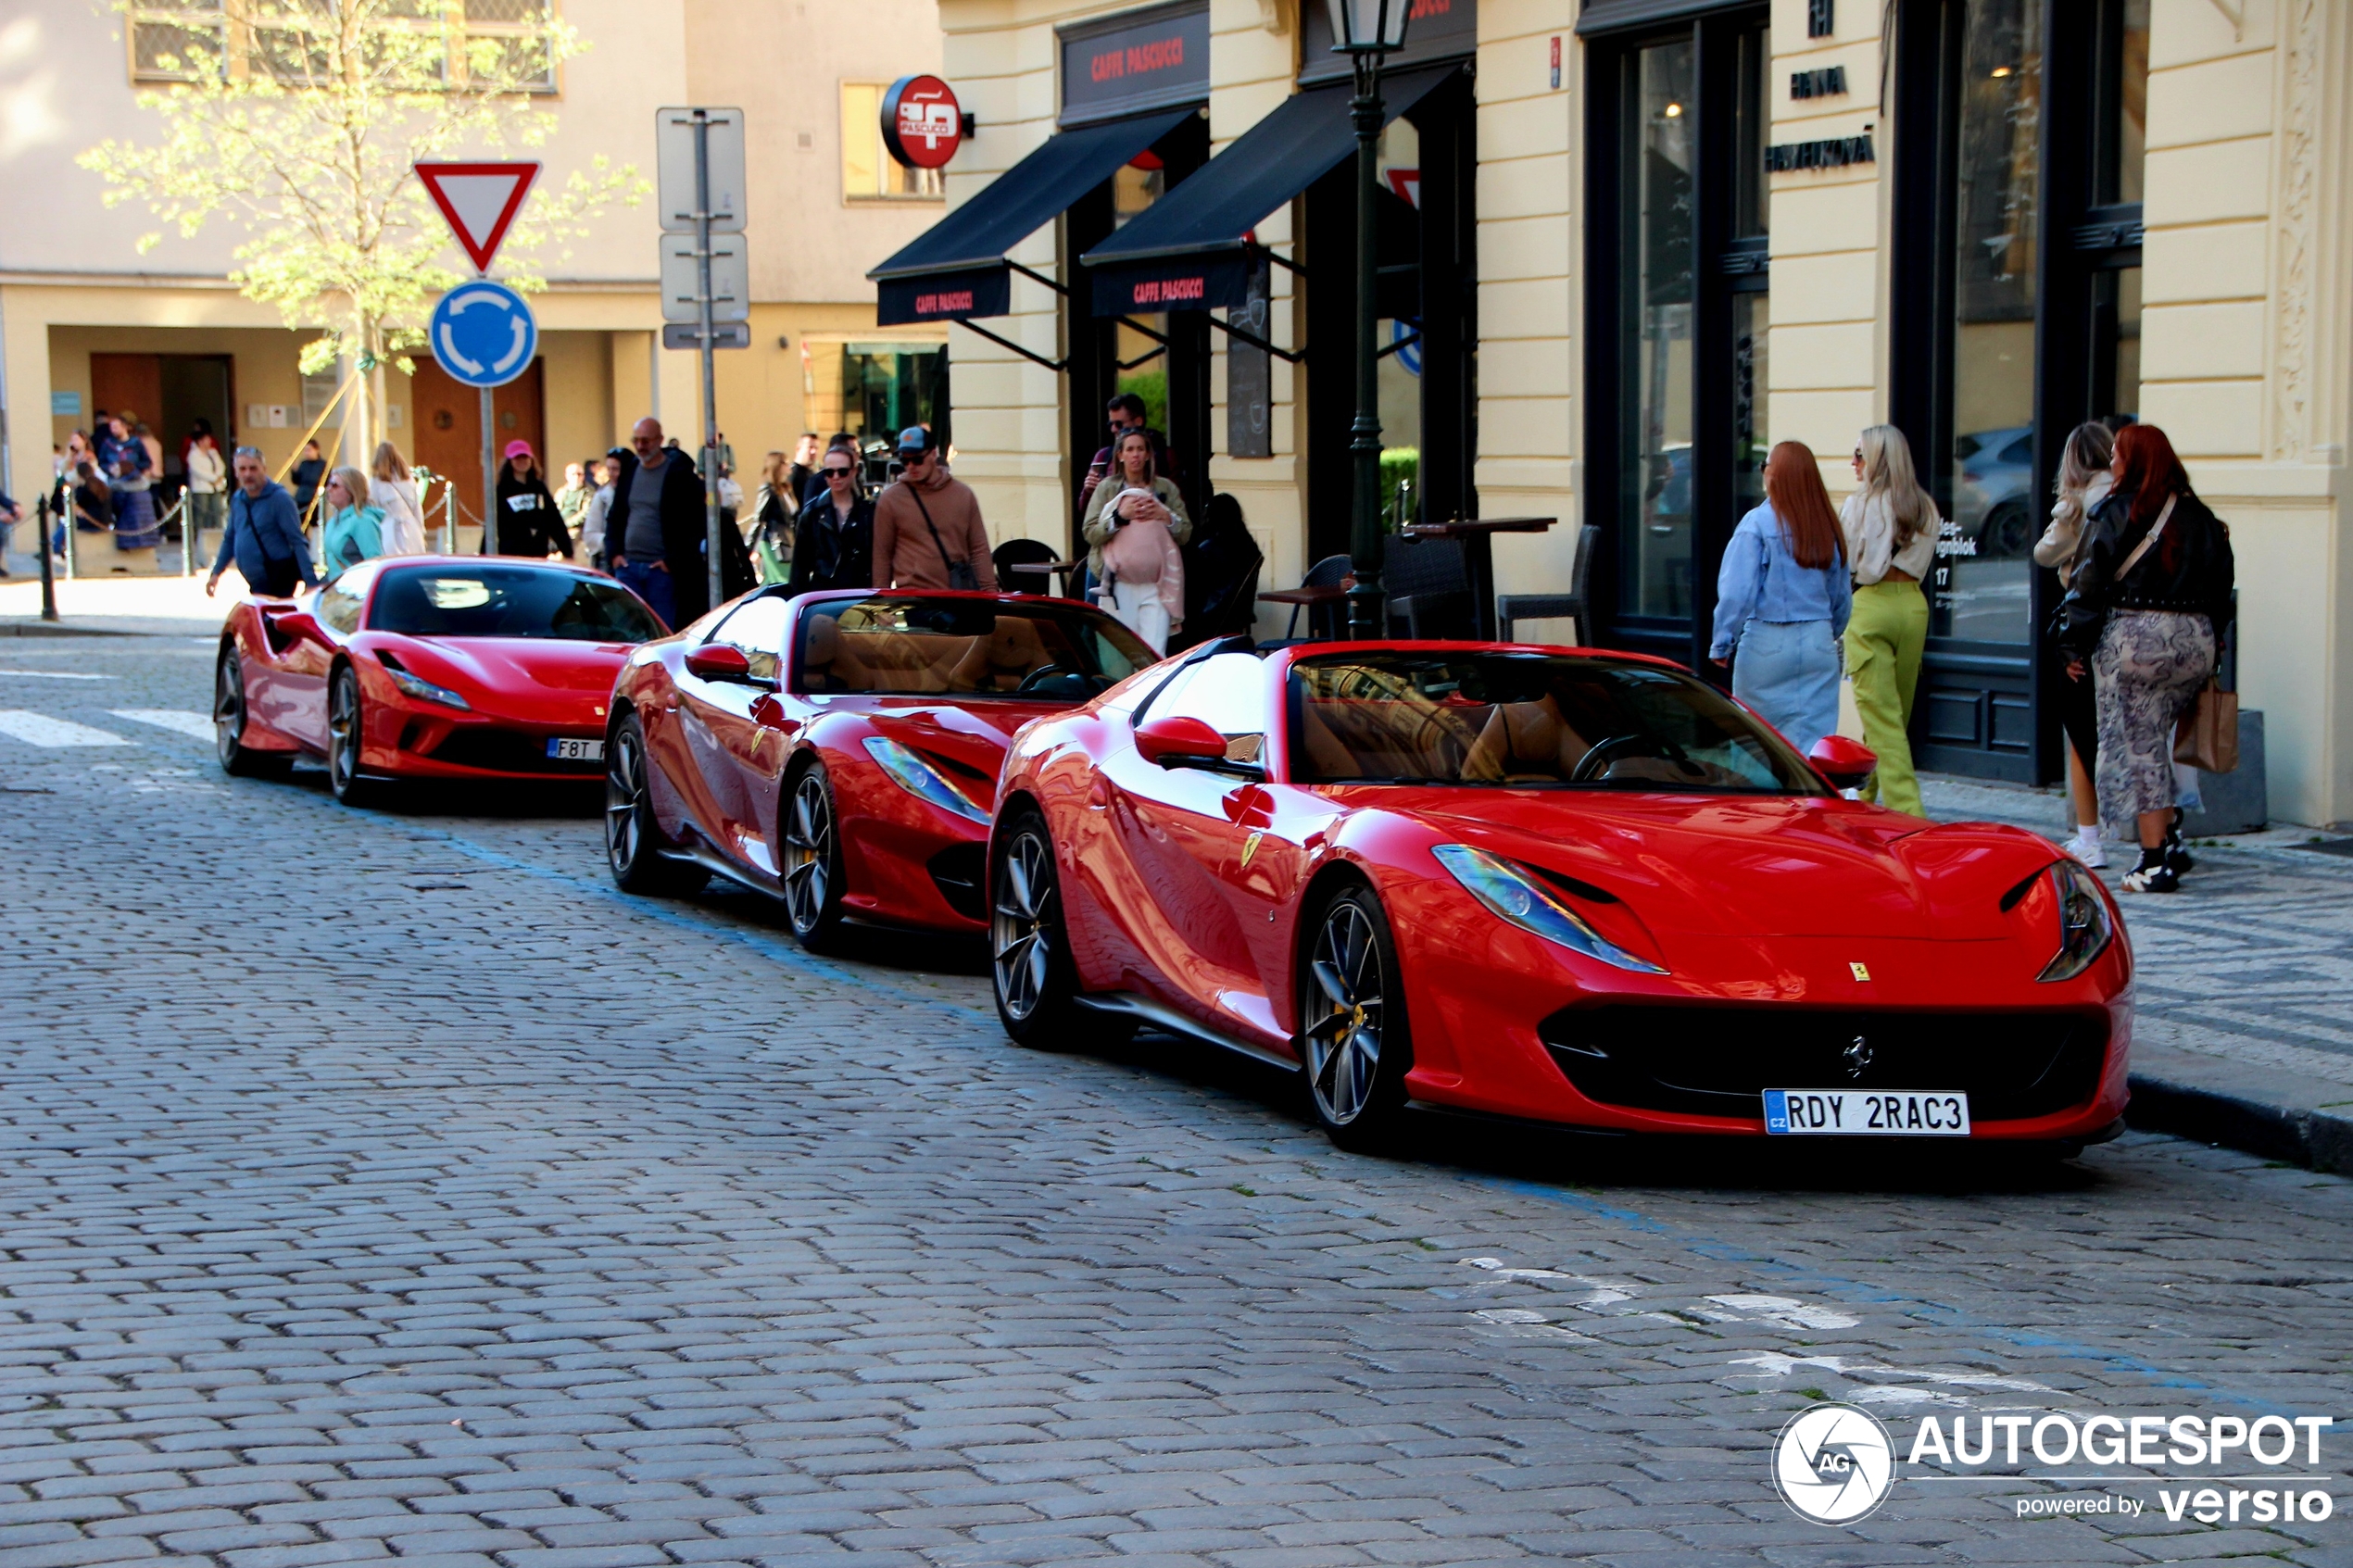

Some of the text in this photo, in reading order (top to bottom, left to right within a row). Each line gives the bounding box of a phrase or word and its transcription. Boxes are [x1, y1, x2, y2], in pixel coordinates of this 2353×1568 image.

[1091, 37, 1183, 82] CAFFE PASCUCCI
[901, 123, 949, 133] PASCUCCI
[1134, 277, 1203, 304] CAFFE PASCUCCI
[938, 290, 973, 311] PASCUCCI
[1935, 568, 1948, 585] 17
[559, 741, 589, 758] F8T
[1787, 1096, 1962, 1129] RDY 2RAC3
[1770, 1118, 1786, 1128] CZ
